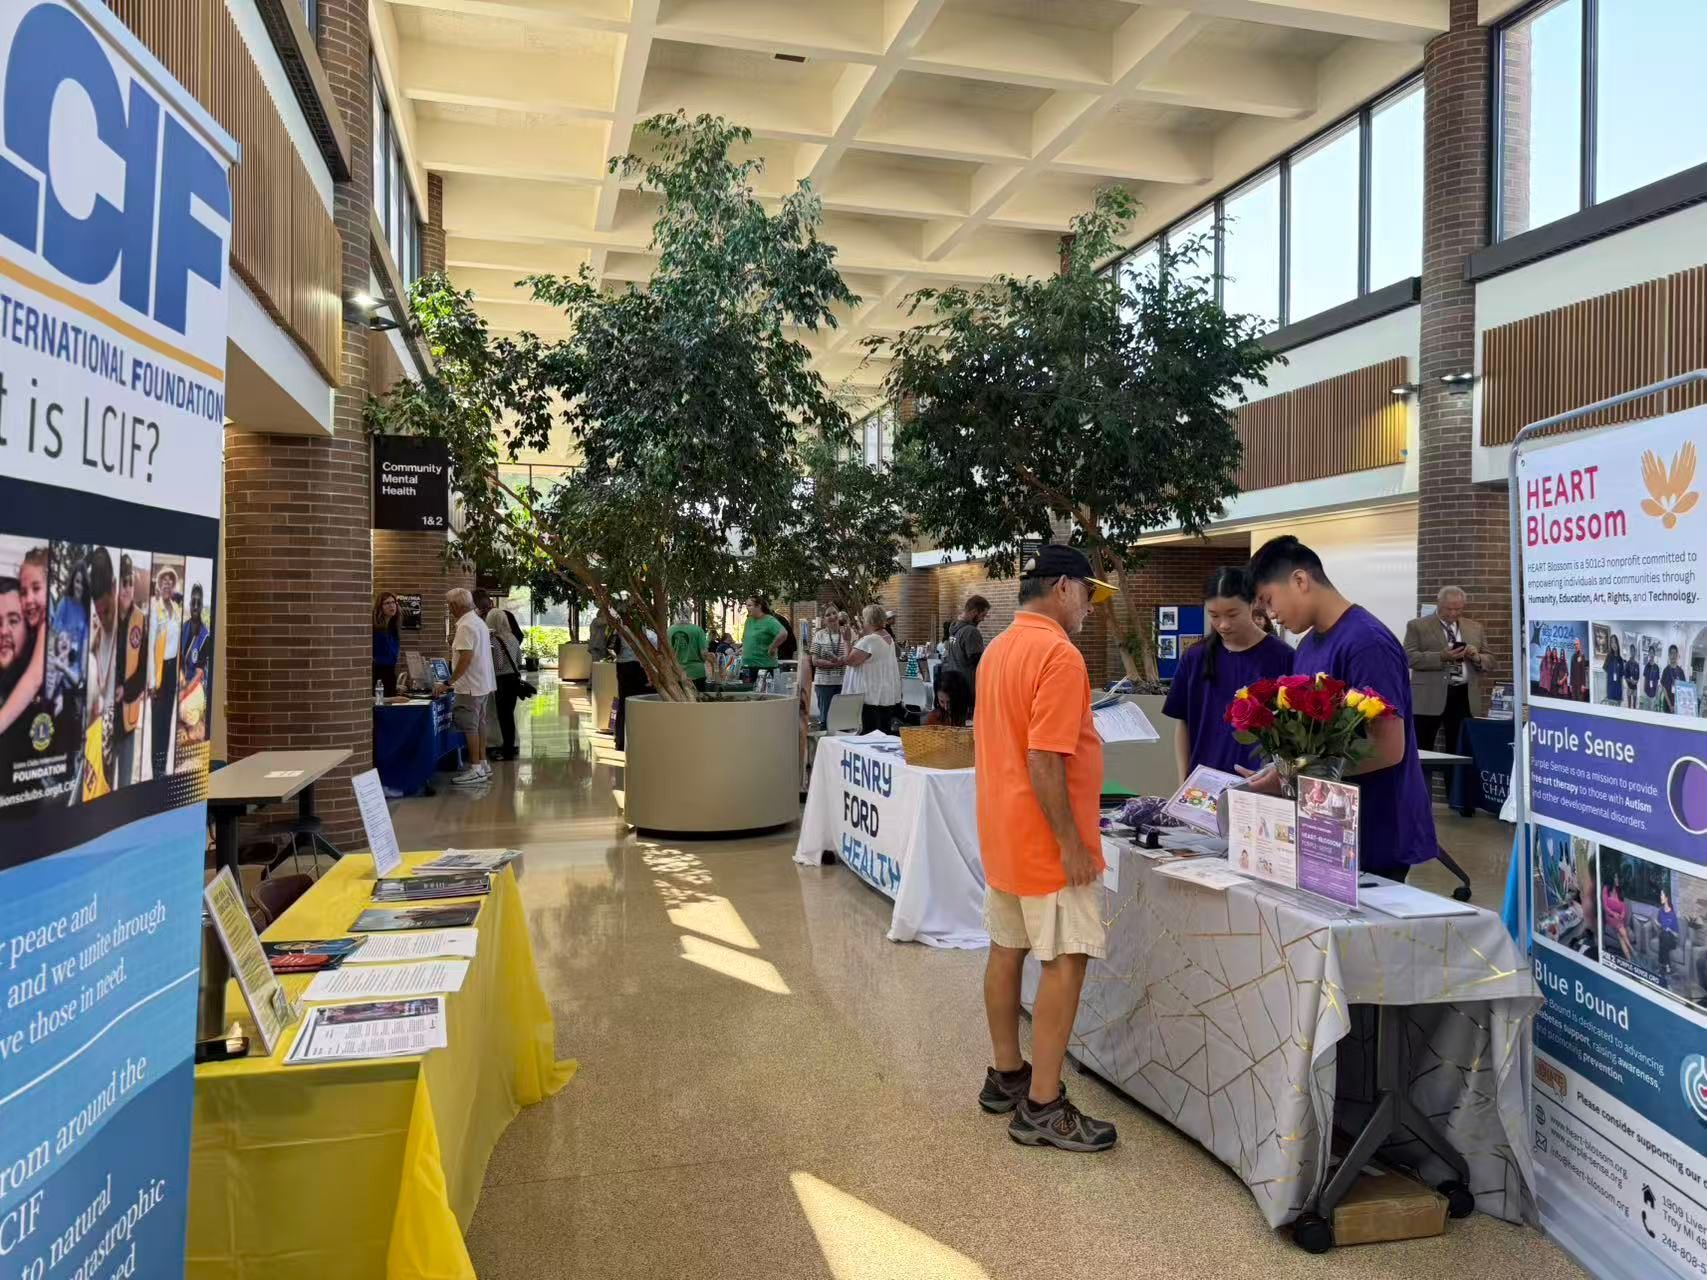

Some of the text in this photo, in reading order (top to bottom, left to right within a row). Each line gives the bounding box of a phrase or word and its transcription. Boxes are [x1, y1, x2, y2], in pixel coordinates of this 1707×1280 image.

[131, 357, 224, 424] FOUNDATION
[28, 377, 64, 459] is
[82, 396, 160, 483] LCIF?
[382, 461, 442, 475] Community
[382, 474, 418, 484] Mental
[1527, 465, 1598, 510] HEART
[382, 486, 416, 496] Health
[422, 516, 443, 526] 1&2
[1527, 509, 1626, 547] Blossom
[1528, 562, 1546, 573] HEART
[1548, 561, 1573, 572] Blossom
[1573, 561, 1579, 570] is
[1585, 558, 1605, 569] 501c3
[1607, 555, 1641, 569] nonprofit
[1642, 551, 1686, 565] committed
[1687, 551, 1697, 562] to
[1528, 570, 1695, 590] empowering individuals and communities through
[1528, 589, 1700, 606] Humanity, Education, Art, Rights, and Technology.
[1530, 721, 1635, 763] Purple Sense
[13, 763, 67, 783] FOUNDATION
[840, 749, 893, 798] HENRY
[1550, 761, 1569, 774] Sense
[1592, 772, 1620, 787] mission
[1619, 778, 1627, 788] to
[1628, 783, 1658, 796] provide
[844, 791, 879, 838] FORD
[1542, 791, 1559, 803] other
[1560, 796, 1610, 819] developmental
[1611, 810, 1647, 830] disorders.
[1553, 778, 1579, 795] therapy
[1579, 786, 1587, 795] to
[1588, 787, 1608, 800] those
[1608, 792, 1624, 805] with
[1625, 797, 1652, 813] Autism
[842, 832, 901, 893] HEALTH
[10, 916, 67, 970] peace
[71, 892, 97, 933] and
[7, 963, 47, 1009] and
[51, 957, 76, 986] we
[79, 933, 112, 970] unite
[112, 899, 166, 947] through
[29, 999, 77, 1045] those
[80, 986, 93, 1013] in
[96, 957, 128, 1001] need.
[1534, 959, 1629, 1031] Blue Bound
[1615, 1035, 1623, 1049] to
[1624, 1043, 1664, 1076] advancing
[1618, 1057, 1661, 1092] awareness,
[56, 1072, 116, 1155] around
[120, 1057, 146, 1094] the
[1577, 1091, 1702, 1185] Please consider supporting our
[49, 1173, 112, 1270] natural
[1662, 1195, 1684, 1218] 1909
[1662, 1209, 1682, 1233] Troy
[1683, 1222, 1695, 1241] MI
[70, 1179, 165, 1280] atastrophic
